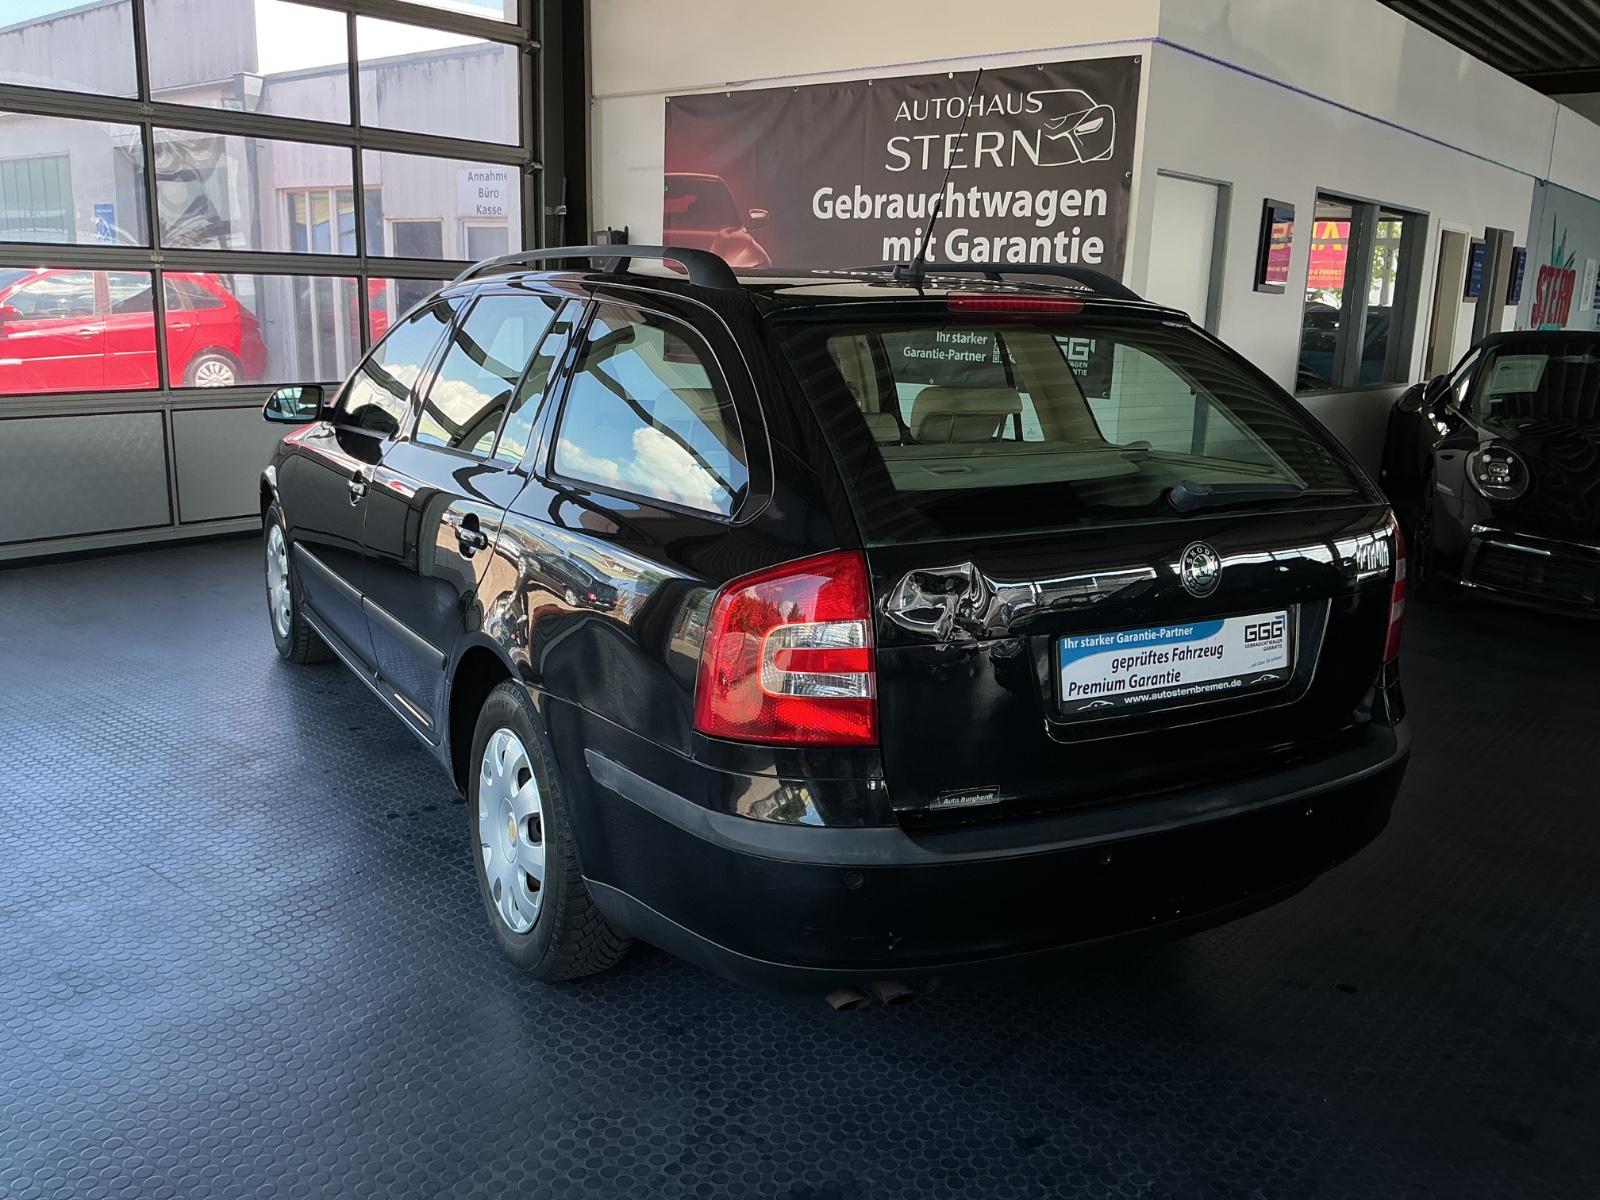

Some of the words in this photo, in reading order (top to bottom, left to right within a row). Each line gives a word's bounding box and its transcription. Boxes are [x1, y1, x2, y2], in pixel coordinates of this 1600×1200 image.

[895, 92, 1043, 122] AUTOHAUS
[885, 129, 1041, 172] STERN
[478, 187, 500, 199] Büro
[812, 182, 1108, 227] Gebrauchtwagen
[476, 204, 502, 215] Kasse
[882, 228, 937, 262] mit
[945, 227, 1104, 264] Garantie
[936, 331, 950, 343] Ihr
[952, 333, 988, 345] starker
[903, 346, 987, 362] Garantie-Partner
[1064, 638, 1080, 649] Ihr
[1081, 635, 1114, 648] starker
[1116, 626, 1194, 643] Garantie-Partner
[1244, 621, 1283, 643] GGG
[1112, 648, 1170, 674] geprüftes
[1172, 643, 1224, 663] Fahrzeug
[1068, 677, 1132, 697] Premium
[1129, 670, 1181, 688] Garantie
[1124, 679, 1242, 705] www.autosternbremen.de
